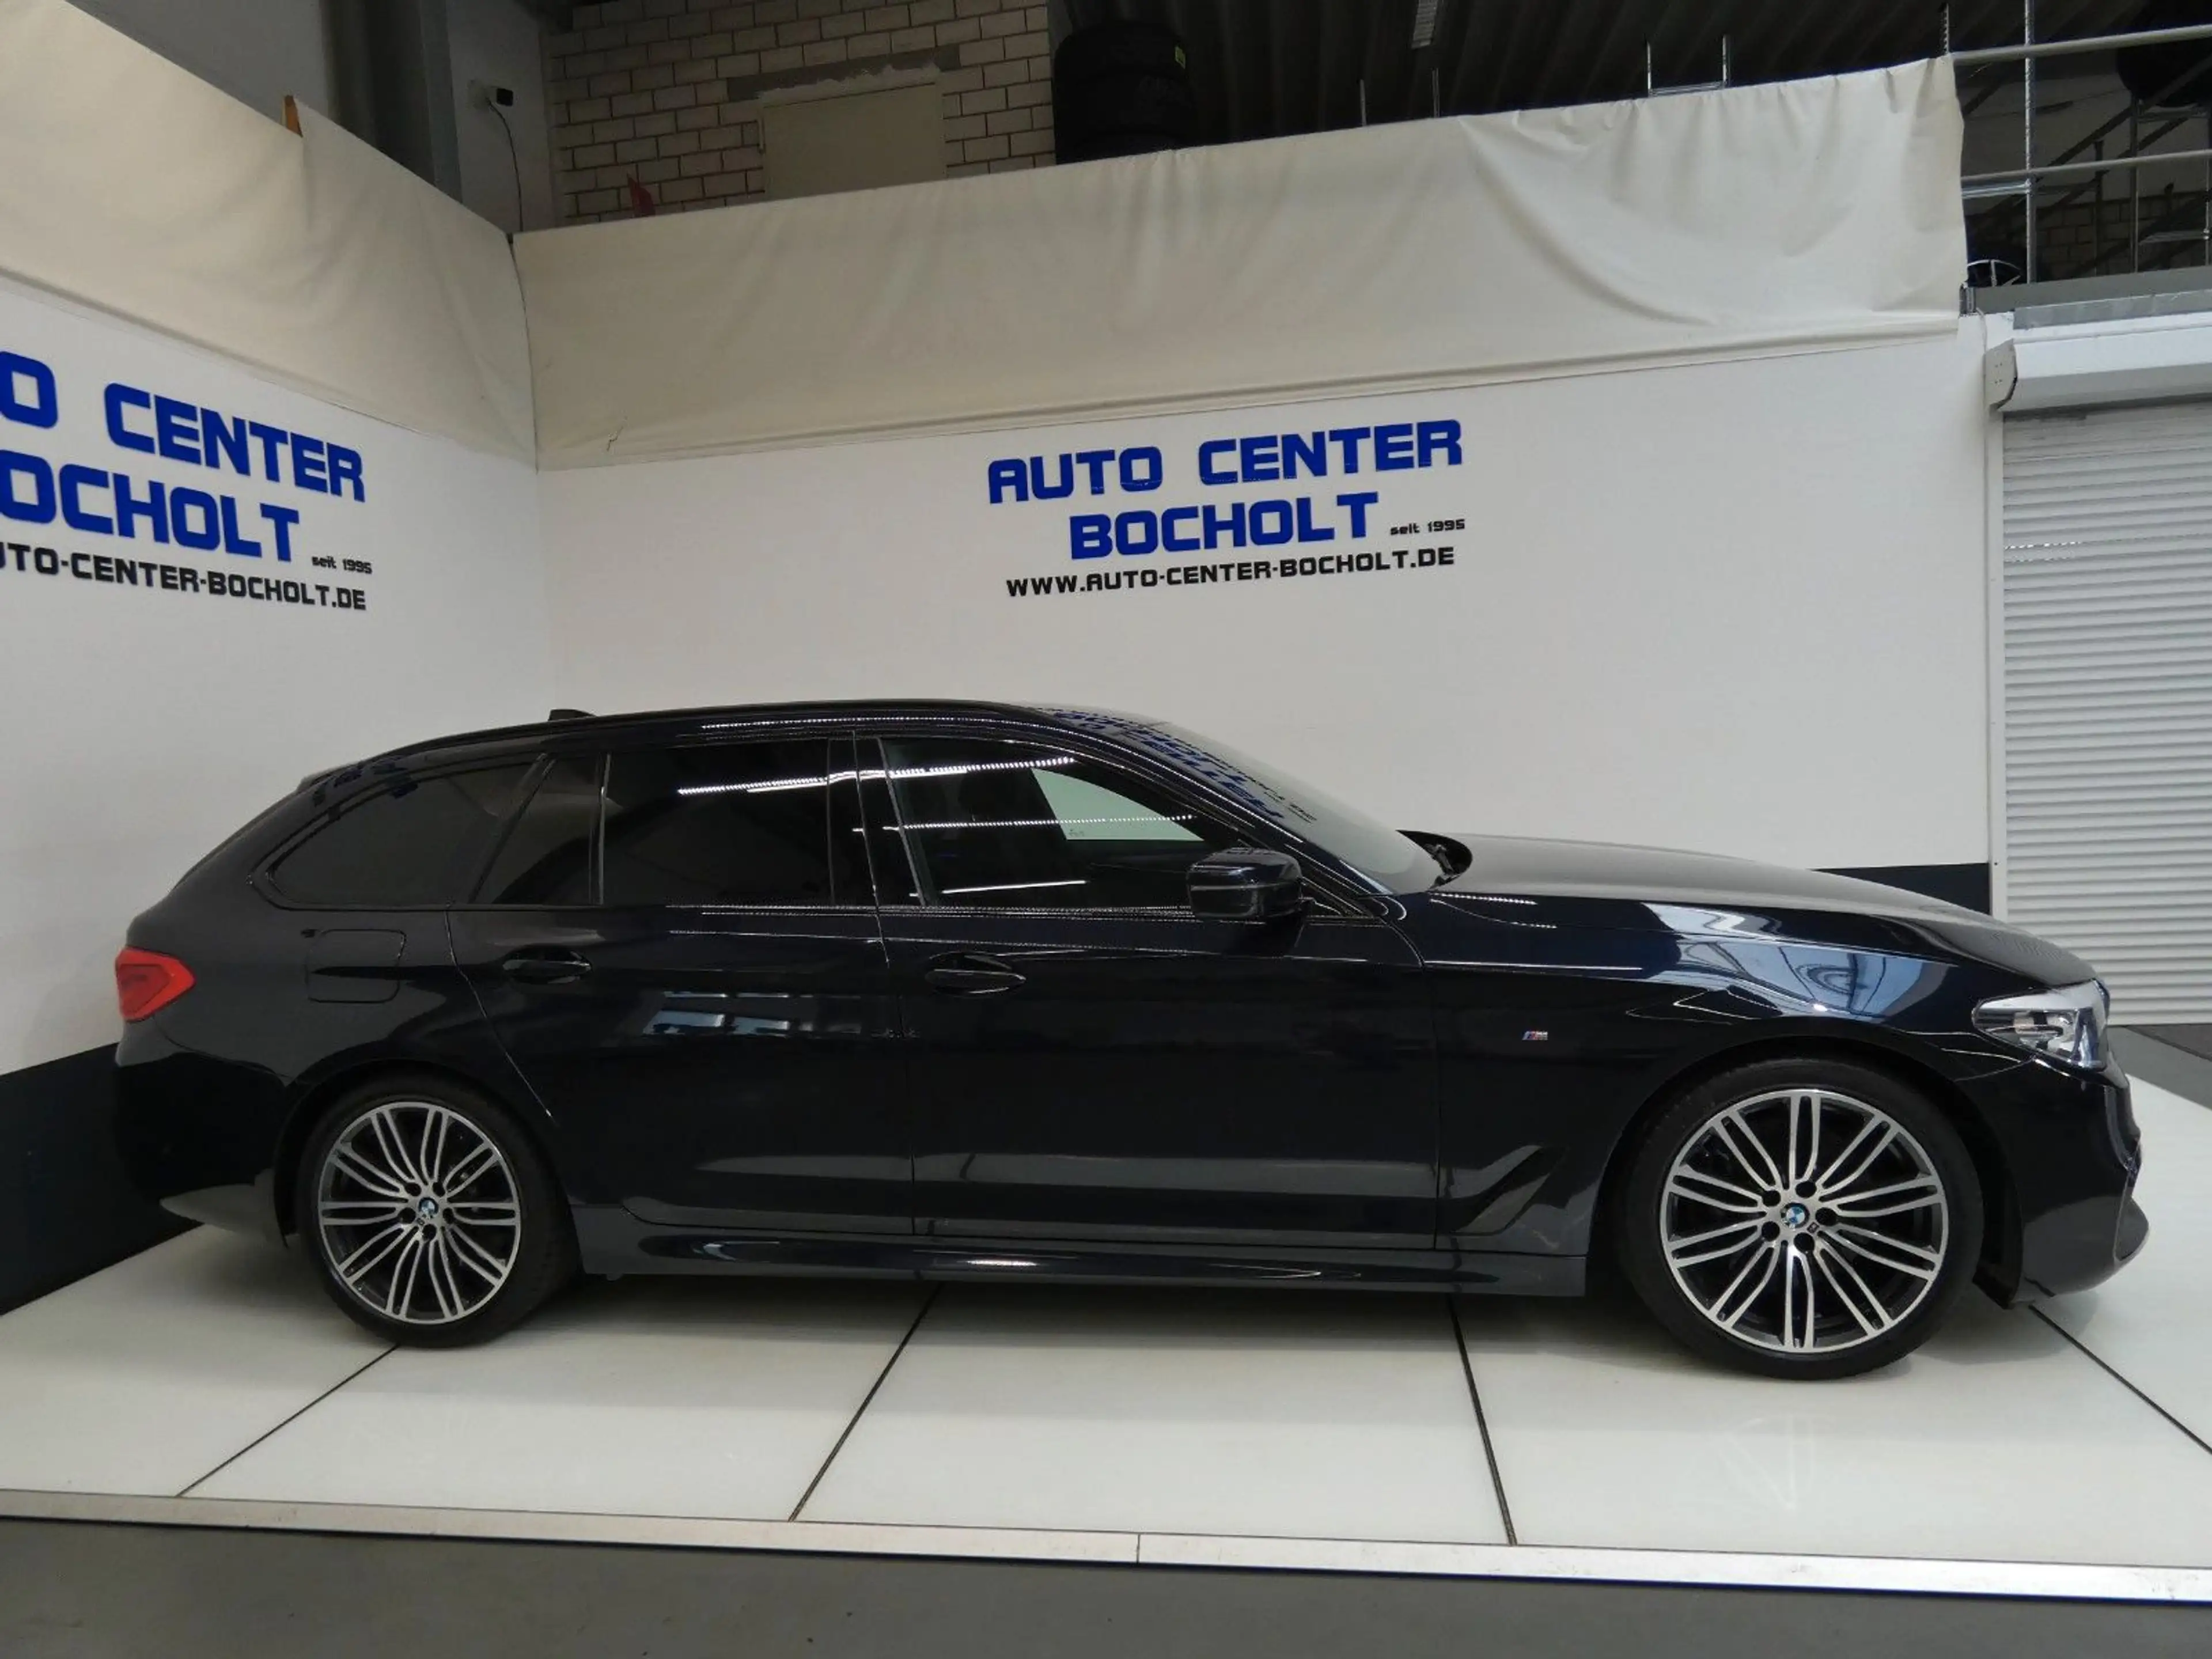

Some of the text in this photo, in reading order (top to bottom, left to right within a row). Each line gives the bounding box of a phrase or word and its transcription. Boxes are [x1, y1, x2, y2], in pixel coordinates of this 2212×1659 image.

[104, 382, 365, 502] CENTER
[988, 419, 1463, 505] AUTO CENTER
[1069, 491, 1465, 560] BOCHOLT seit 1995
[0, 541, 367, 611] TO-CENTER-BOCHOLT.DE
[312, 555, 338, 570] seit
[342, 558, 373, 574] 1995
[1006, 546, 1455, 597] WWW.AUTO-CENTER-BOCHOLT.DE
